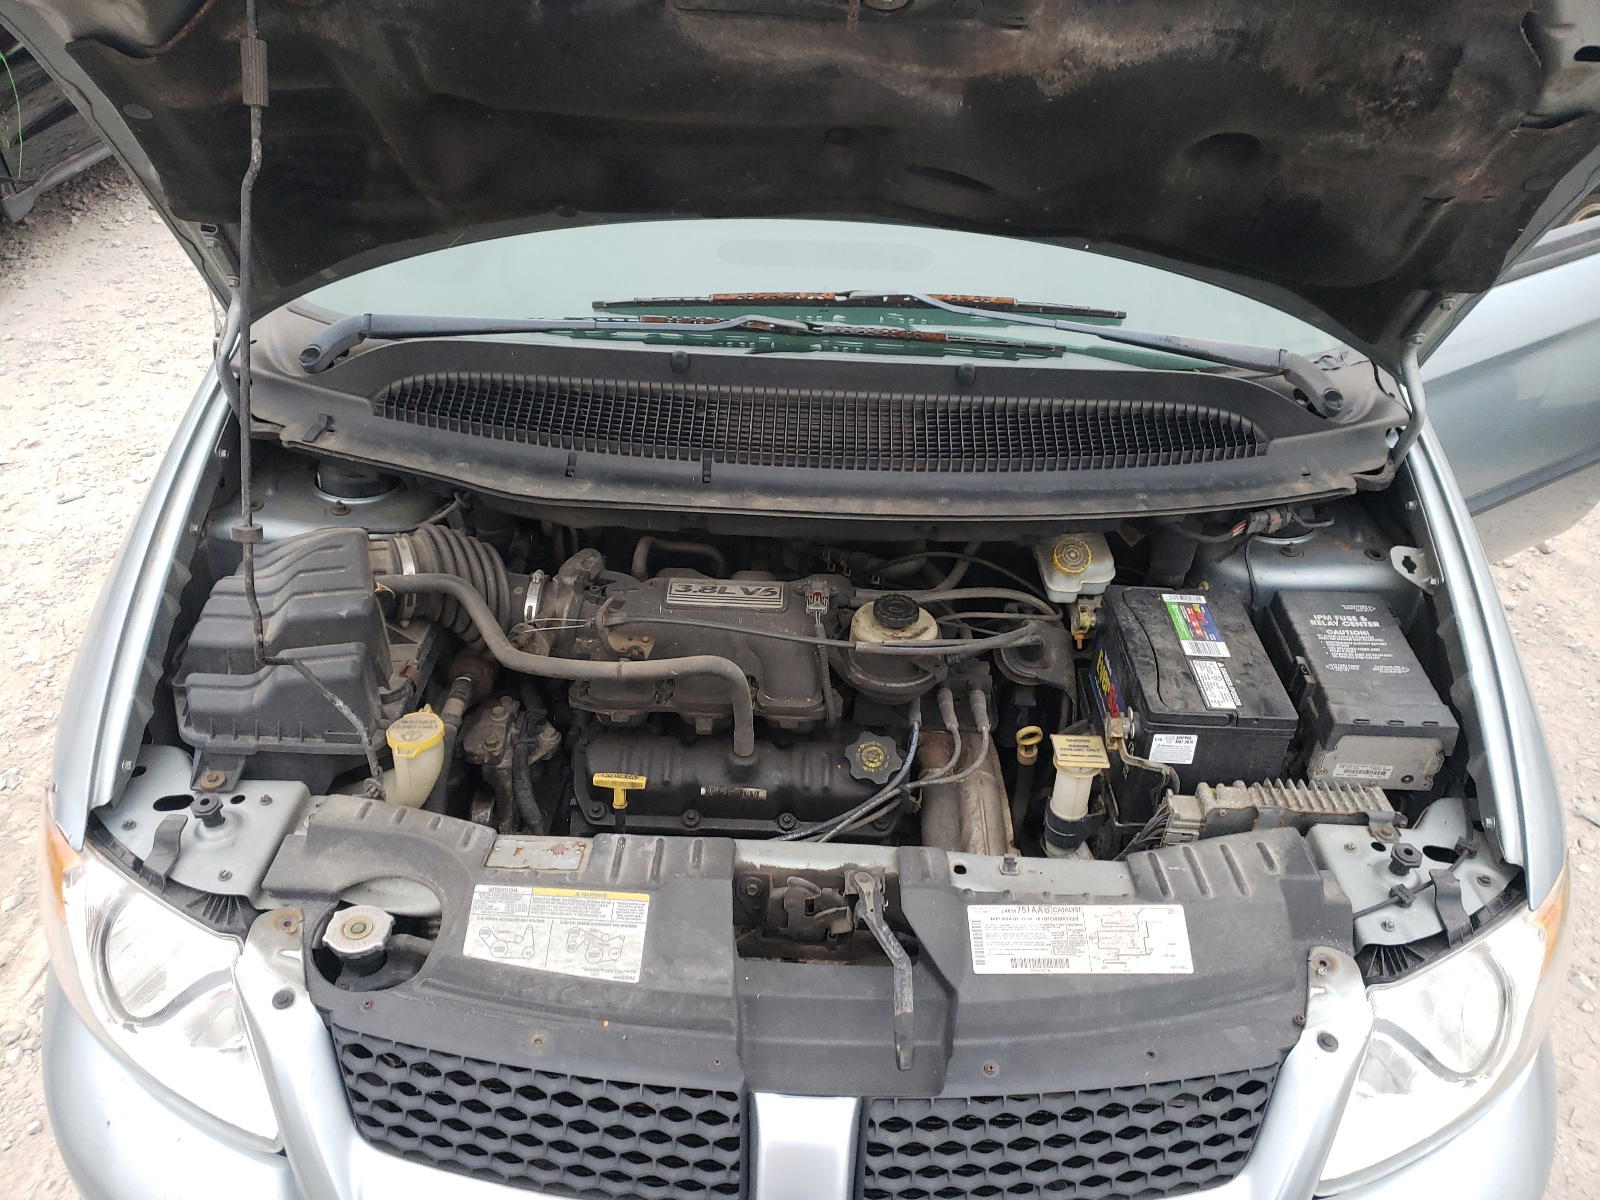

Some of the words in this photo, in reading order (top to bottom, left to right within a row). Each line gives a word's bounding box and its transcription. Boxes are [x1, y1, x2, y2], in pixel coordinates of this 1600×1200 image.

[674, 583, 737, 595] 3.8L
[739, 586, 778, 597] V6
[1309, 619, 1339, 627] RELAY
